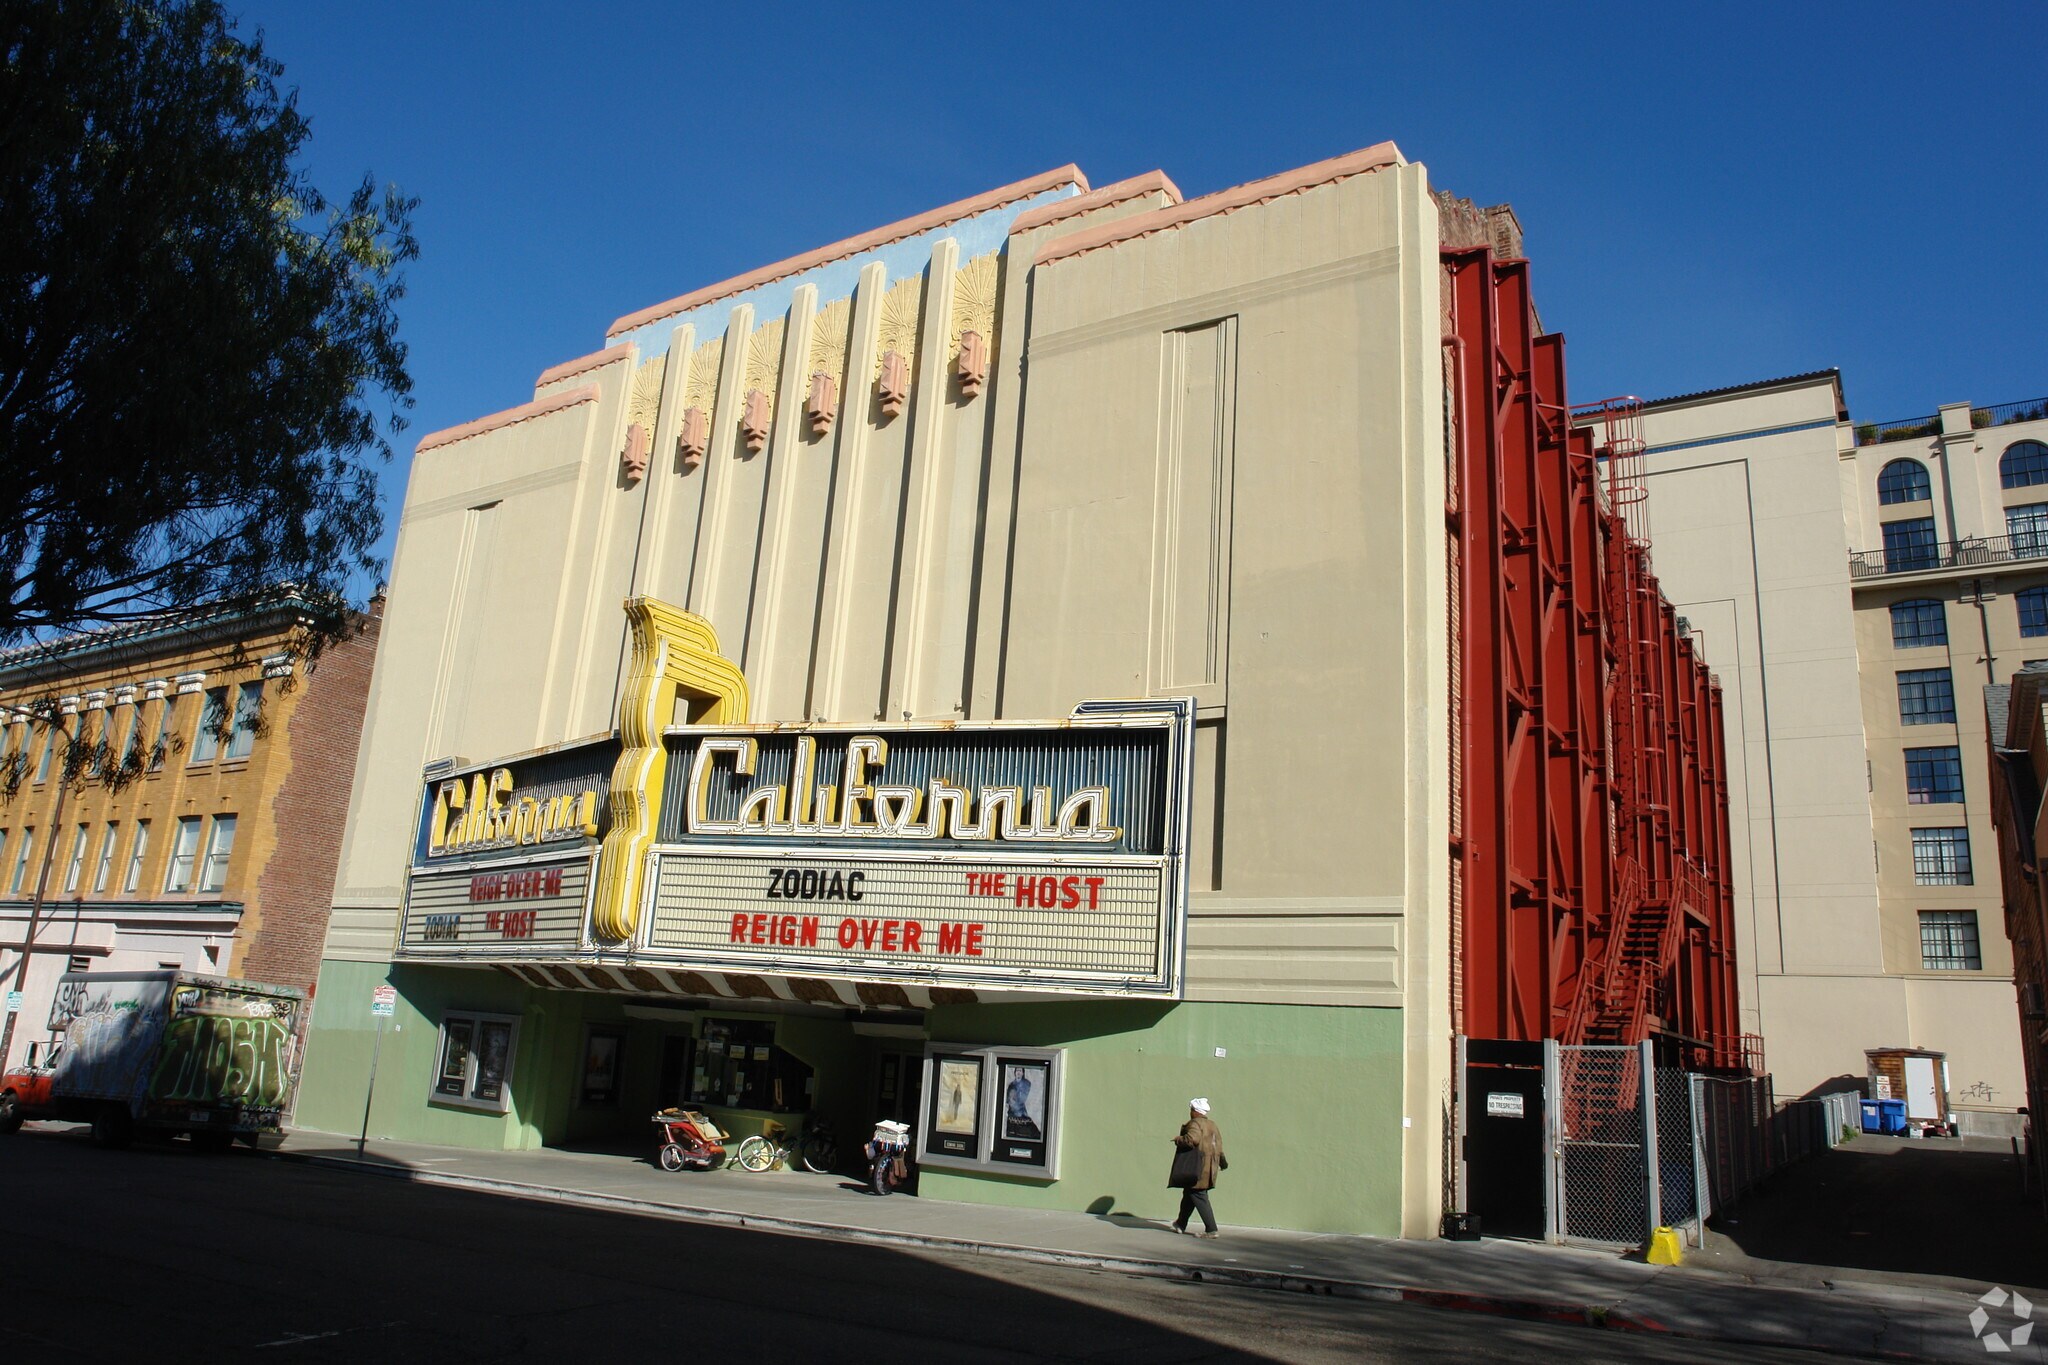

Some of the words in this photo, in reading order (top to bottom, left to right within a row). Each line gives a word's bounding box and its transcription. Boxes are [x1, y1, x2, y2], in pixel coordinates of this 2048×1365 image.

[687, 735, 1123, 843] California
[470, 872, 503, 901] REIGN
[504, 871, 540, 899] OVER
[544, 868, 563, 896] ME
[766, 868, 866, 902] ZODIAC
[966, 872, 1006, 898] THE
[1016, 875, 1105, 911] HOST
[423, 914, 462, 941] ZODIAC
[485, 911, 501, 930] THE
[502, 911, 538, 939] HOST
[730, 913, 819, 948] REIGN
[837, 917, 923, 953] OVER
[938, 923, 984, 956] ME
